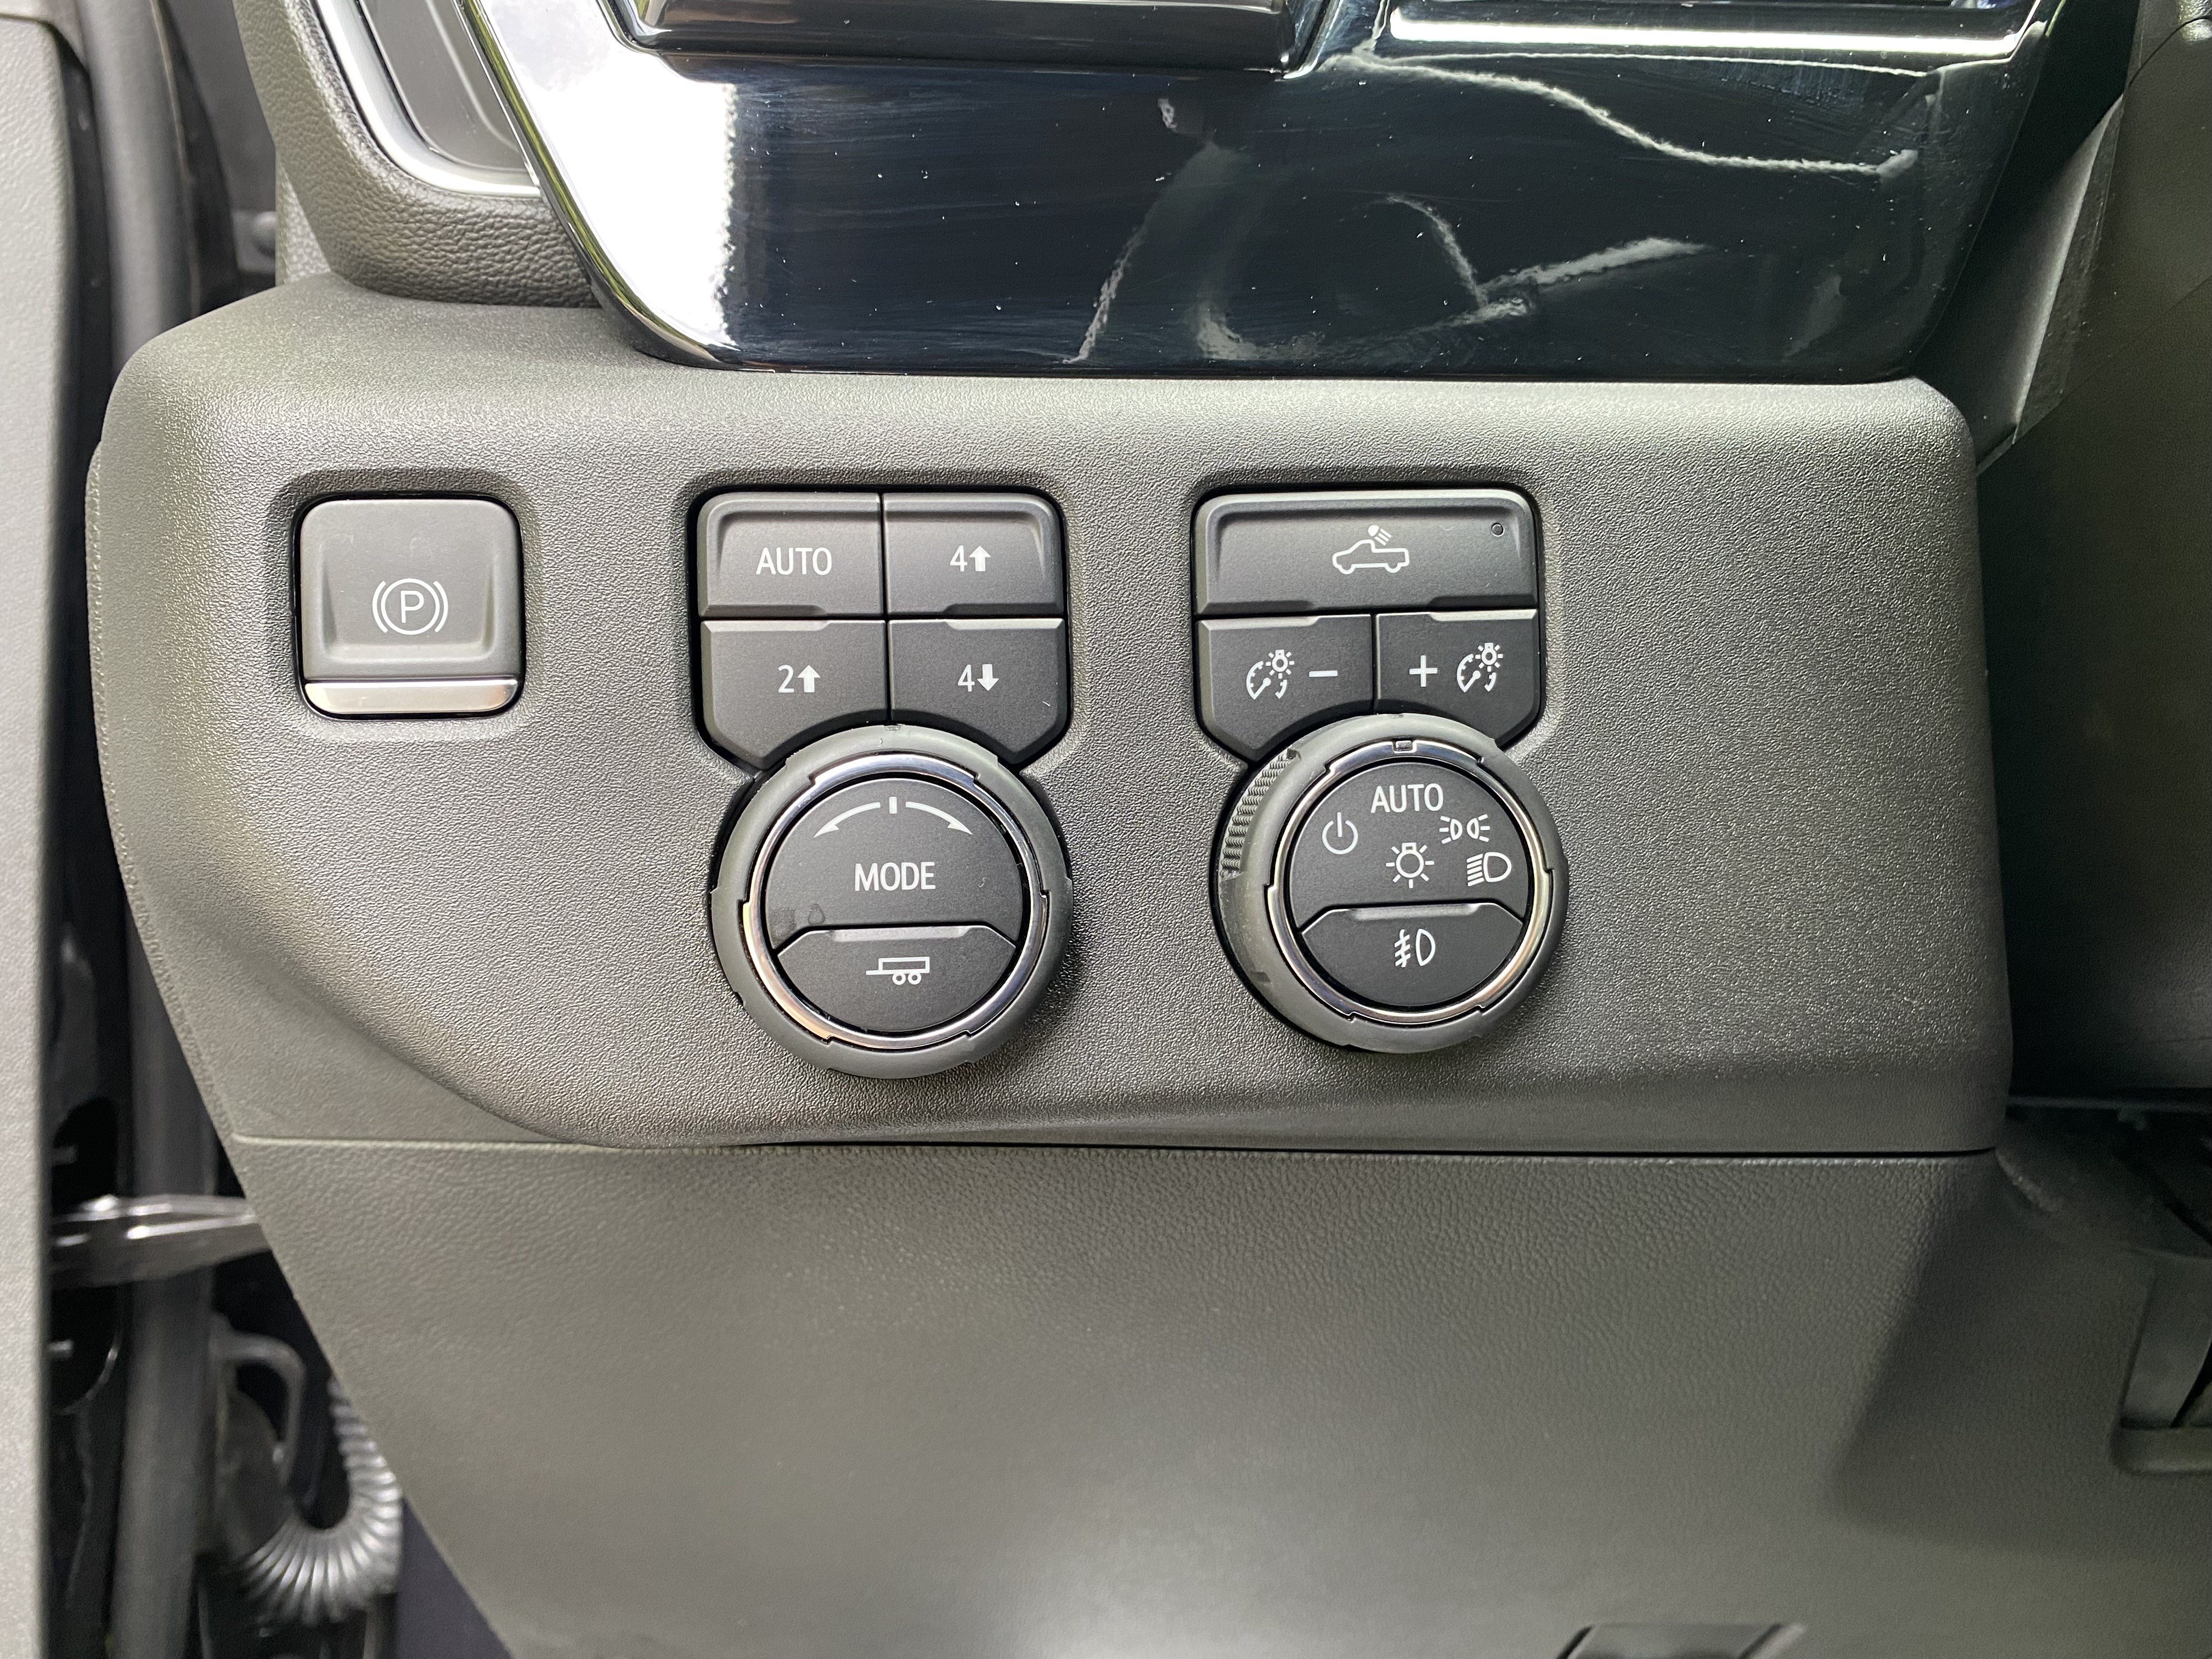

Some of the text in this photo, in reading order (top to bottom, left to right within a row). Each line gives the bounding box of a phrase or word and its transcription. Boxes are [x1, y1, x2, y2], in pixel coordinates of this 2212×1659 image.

[756, 547, 832, 575] AUTO
[950, 545, 968, 572] 4
[400, 590, 425, 623] P
[778, 664, 794, 693] 2
[957, 664, 975, 692] 4
[1370, 783, 1443, 814] AUTO
[855, 861, 936, 891] MODE
